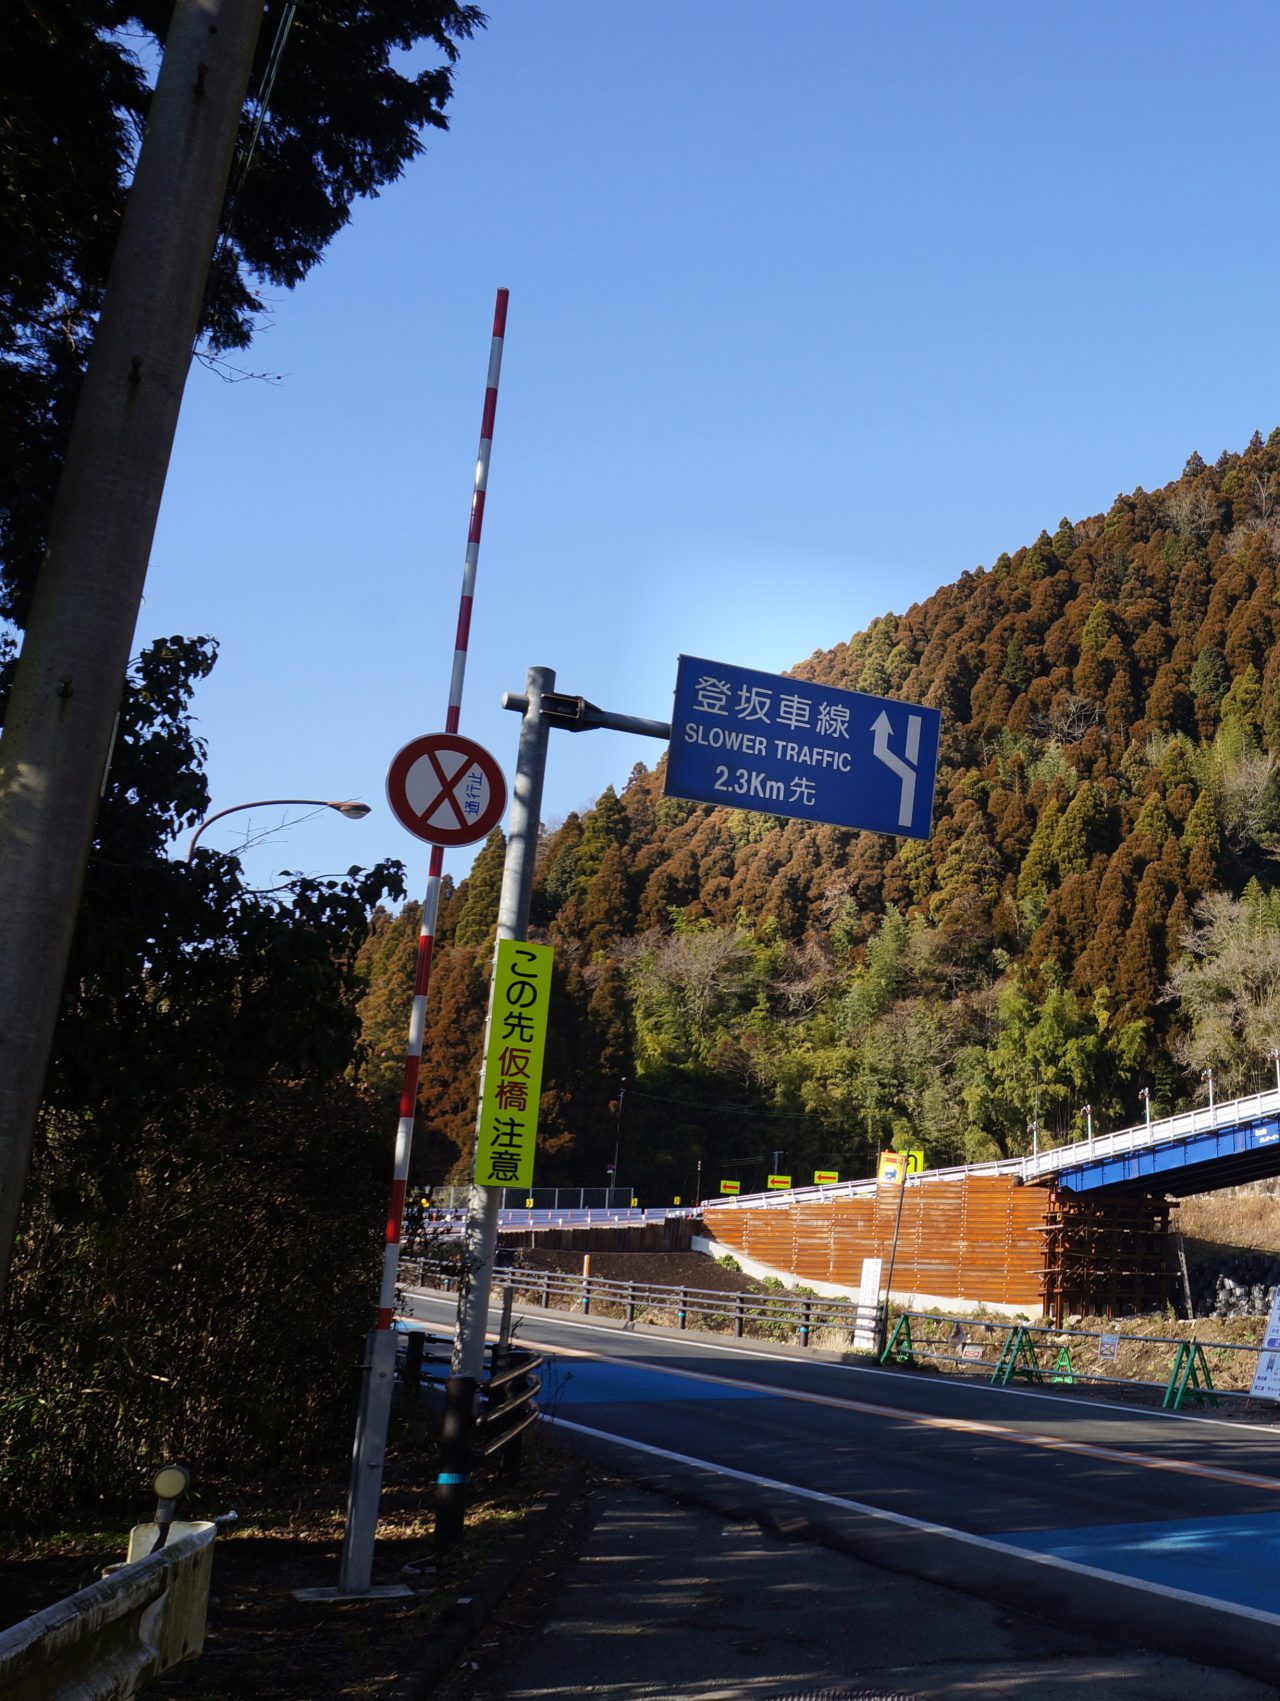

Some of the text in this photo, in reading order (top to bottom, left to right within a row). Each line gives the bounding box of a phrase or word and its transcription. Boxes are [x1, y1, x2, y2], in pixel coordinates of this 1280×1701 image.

[692, 675, 851, 740] 登坂車線
[684, 722, 852, 773] SLOWER TRAFFIC
[464, 772, 483, 816] 通行止
